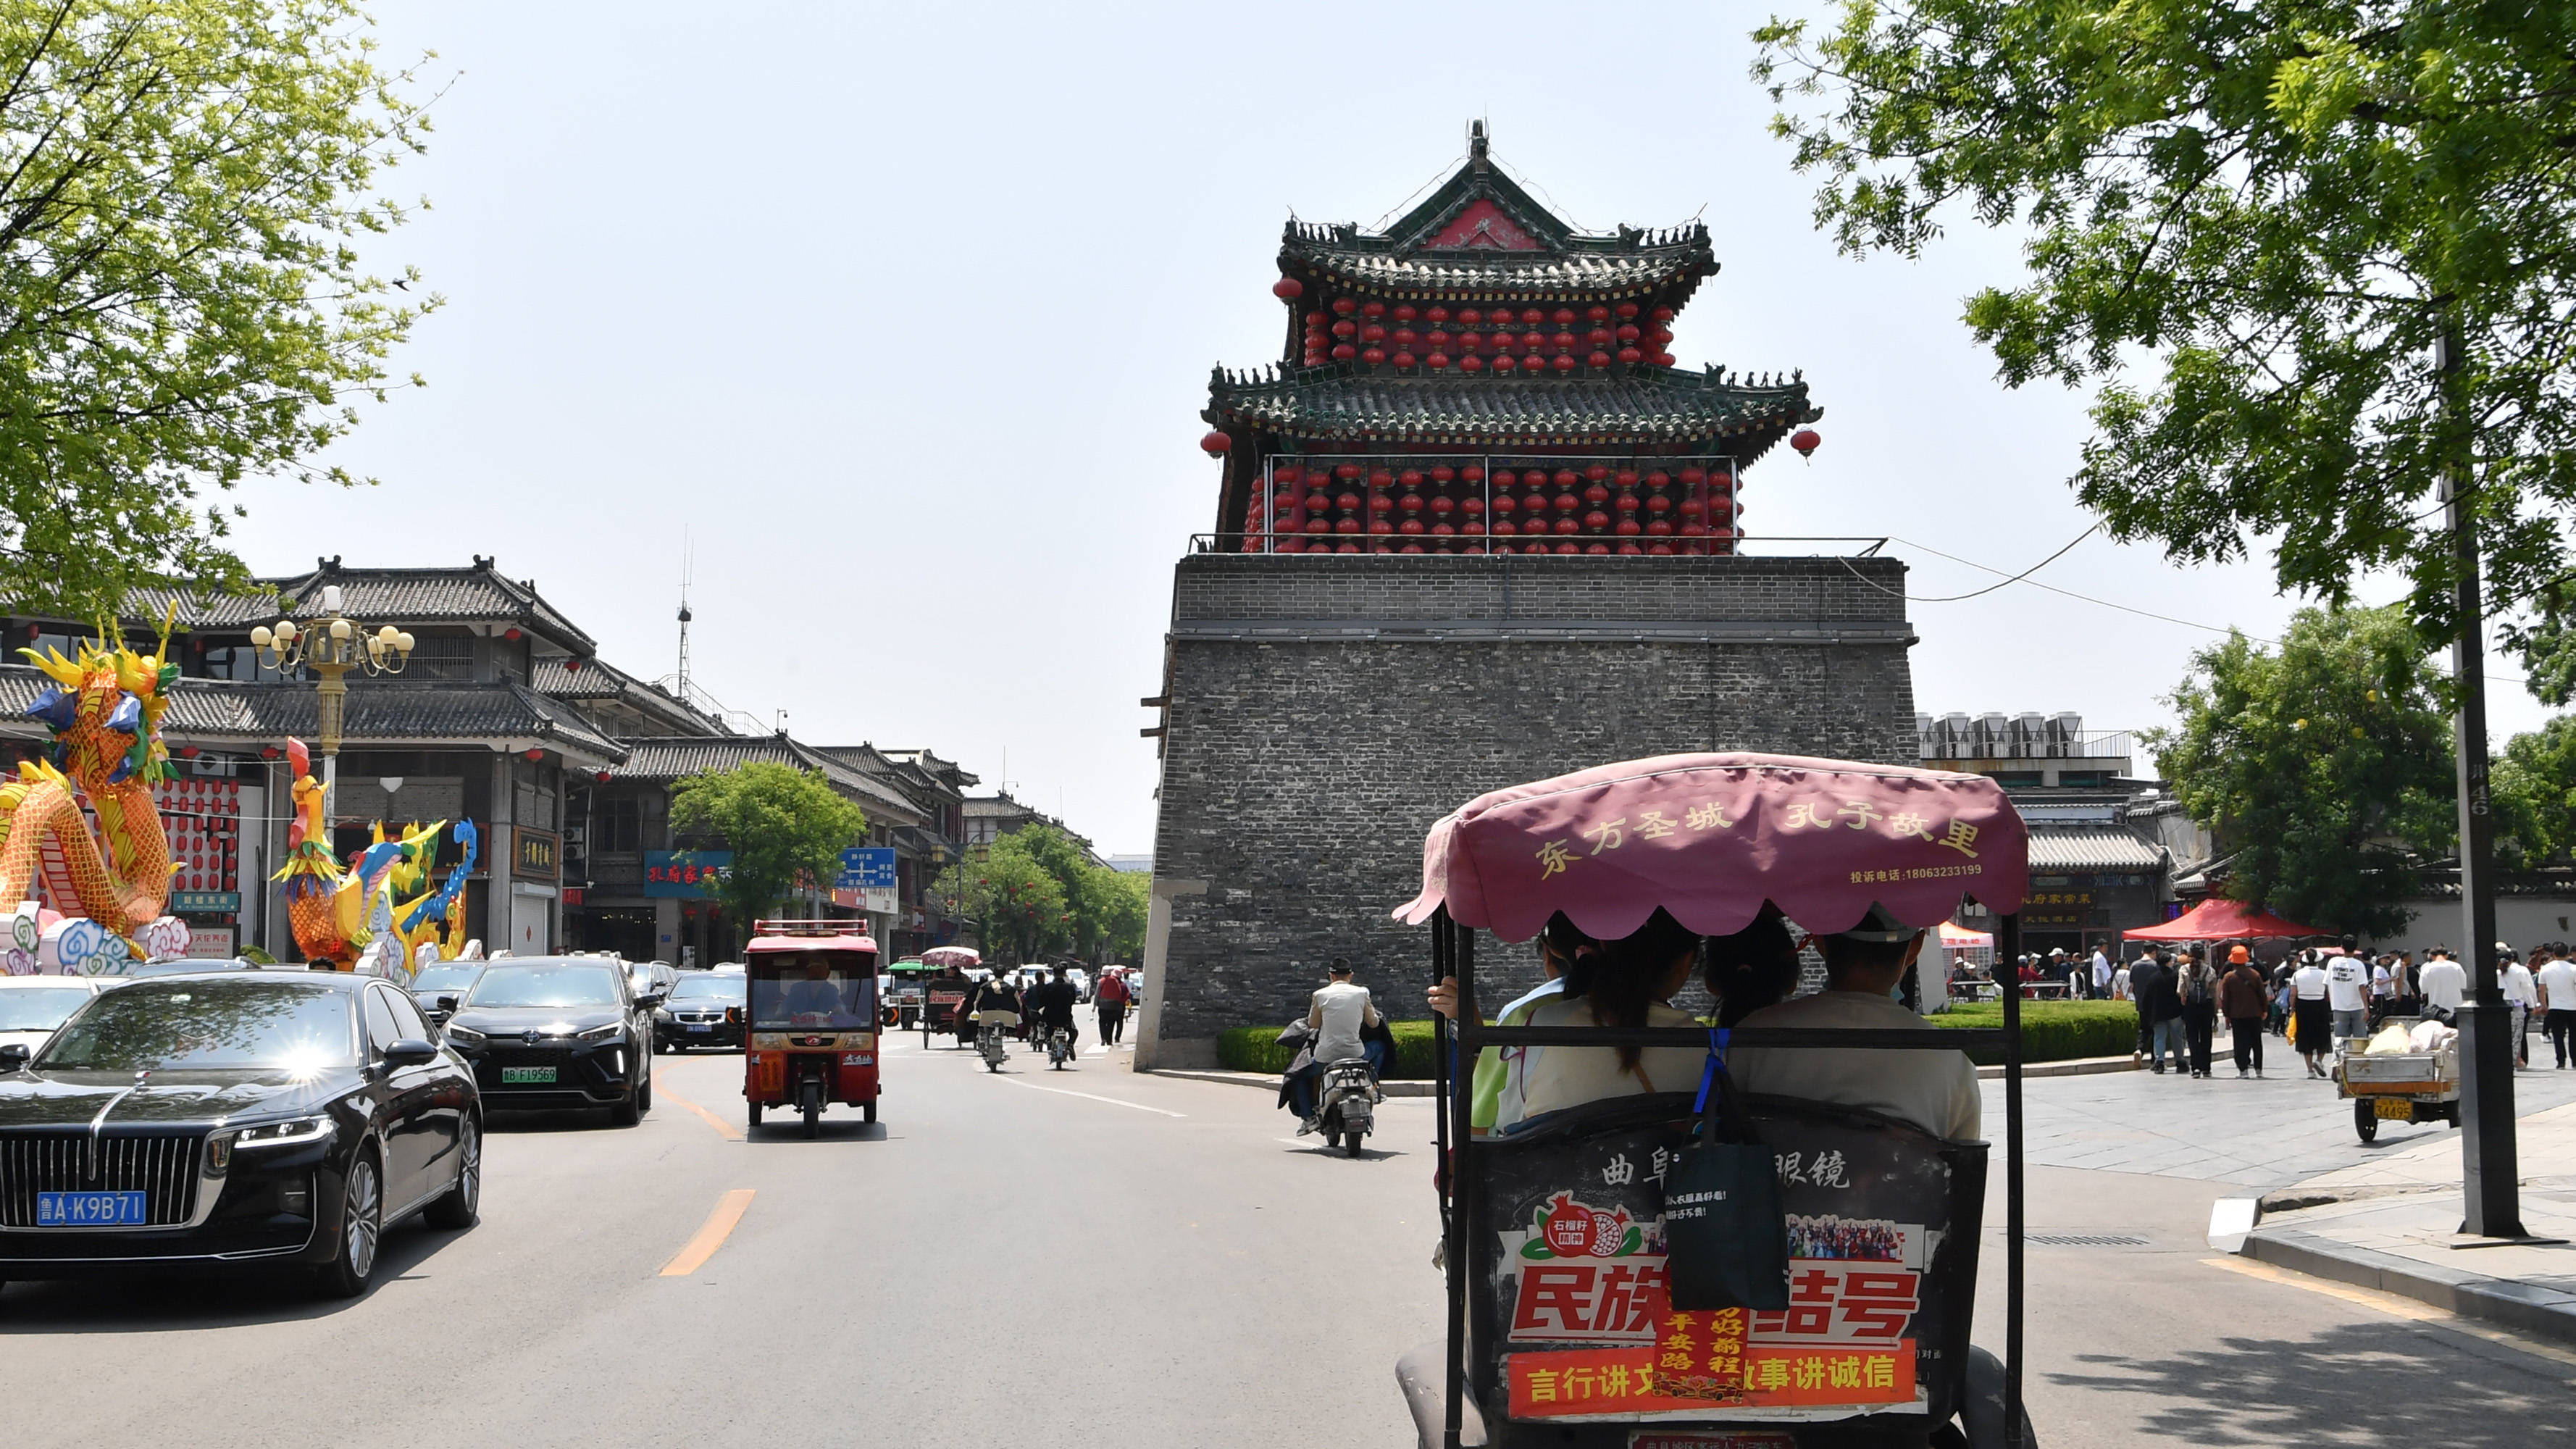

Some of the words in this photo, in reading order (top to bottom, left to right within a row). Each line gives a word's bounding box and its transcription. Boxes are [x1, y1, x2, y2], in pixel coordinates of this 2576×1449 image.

[1535, 802, 1734, 881] 东方圣城
[1784, 801, 1979, 859] 孔子故里
[1554, 1219, 1588, 1231] 石榴籽
